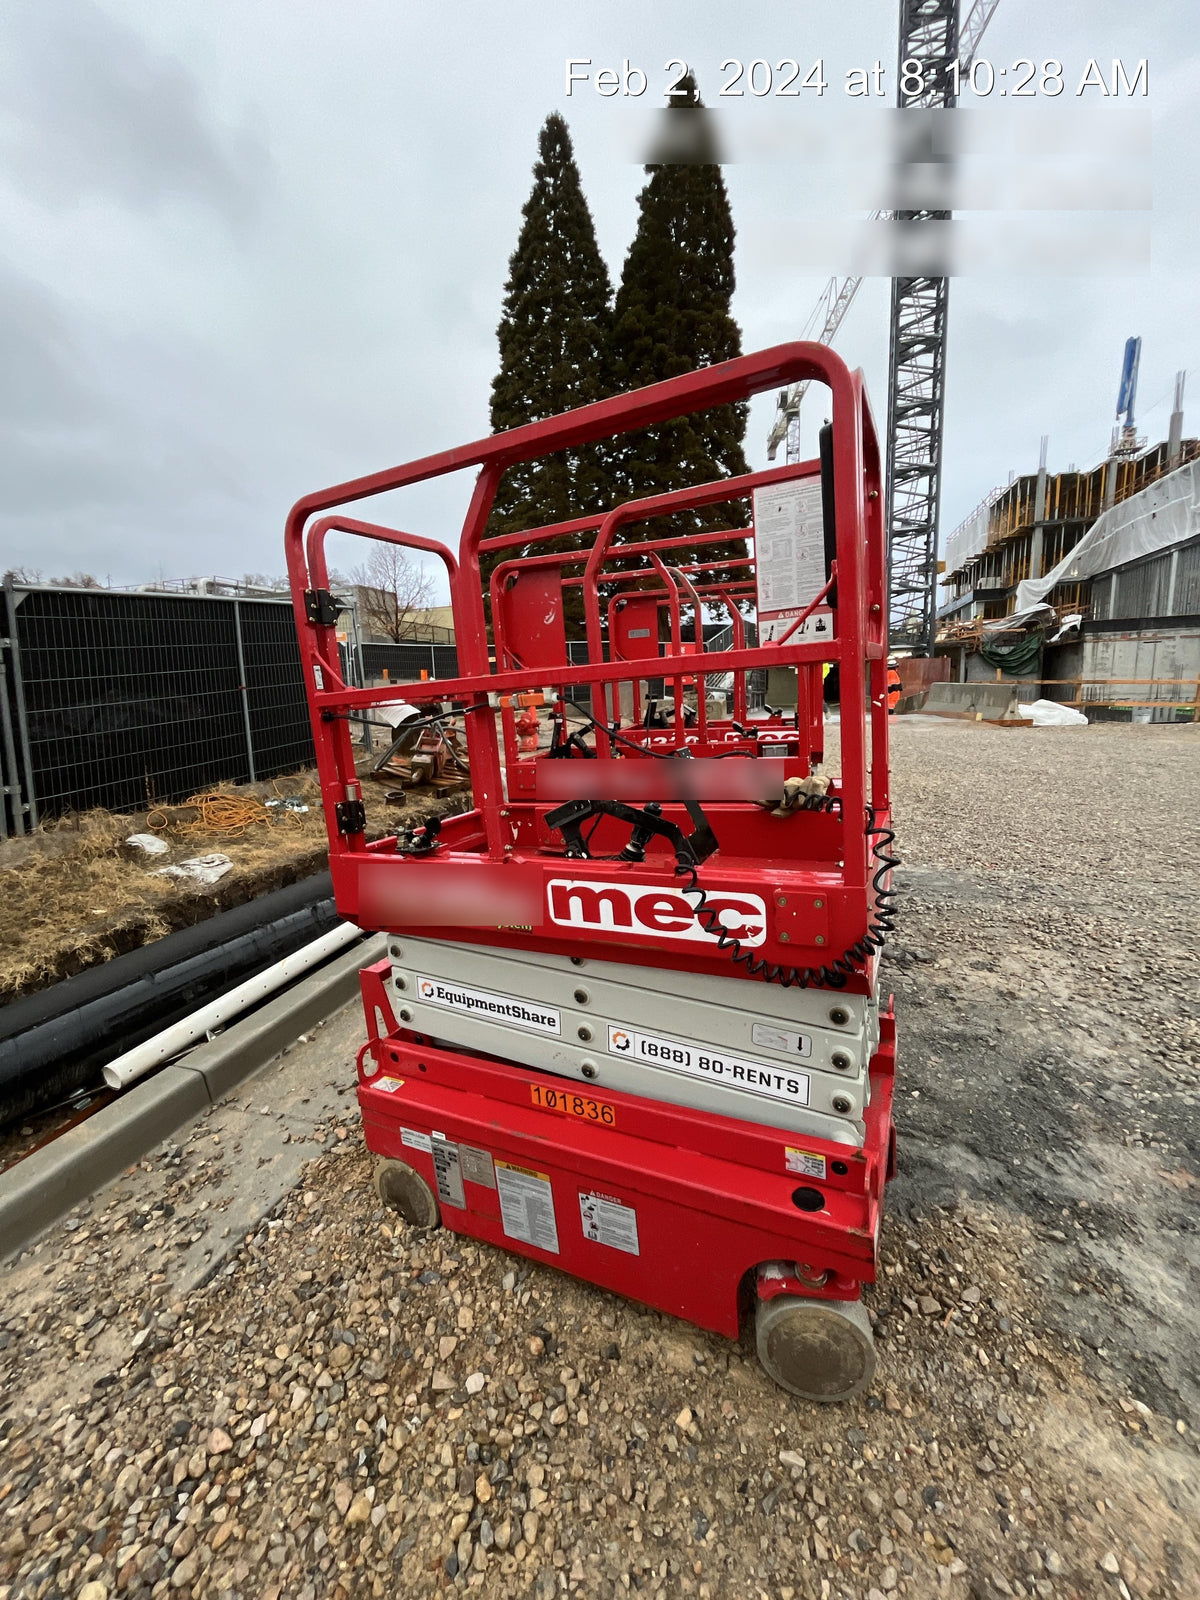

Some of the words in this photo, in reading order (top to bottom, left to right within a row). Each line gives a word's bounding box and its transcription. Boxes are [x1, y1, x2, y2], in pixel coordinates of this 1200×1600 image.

[551, 885, 764, 940] mec
[436, 986, 556, 1027] EquipmentShare
[641, 1040, 691, 1066] (888)
[698, 1056, 800, 1094] 80-RENTS
[533, 1086, 614, 1124] 101836
[511, 1165, 538, 1178] WARNING
[596, 1191, 622, 1204] DANGER
